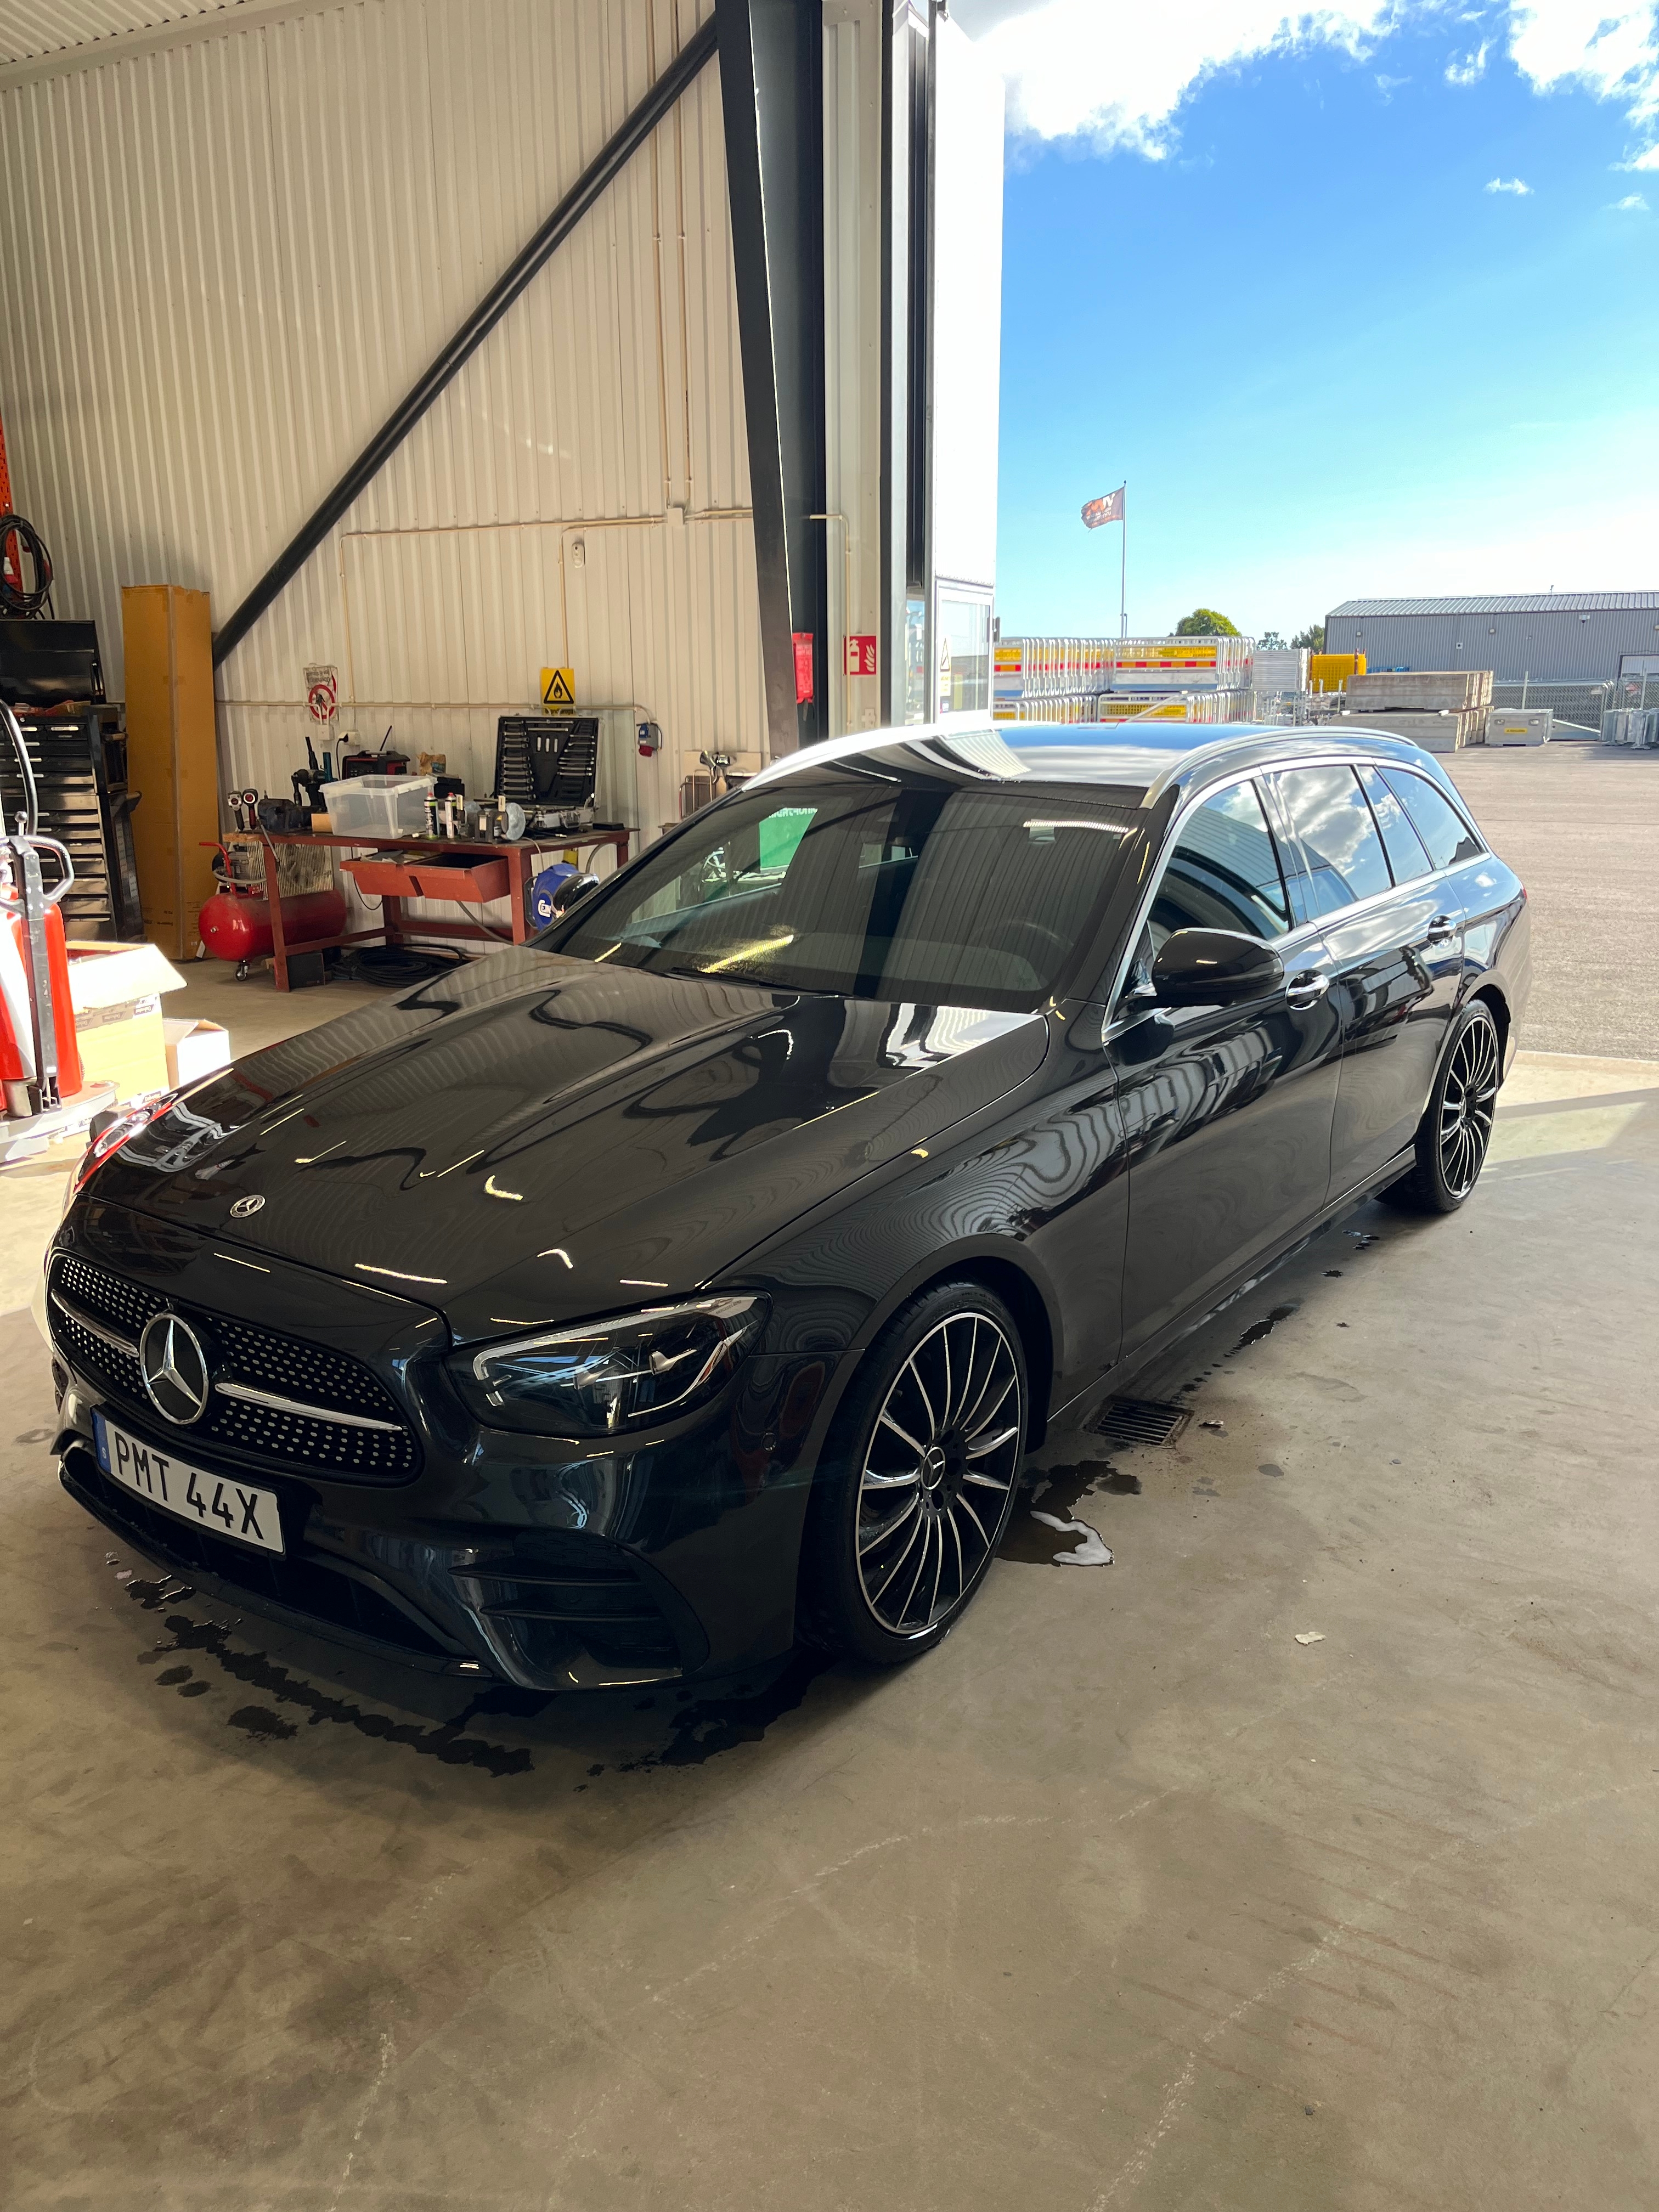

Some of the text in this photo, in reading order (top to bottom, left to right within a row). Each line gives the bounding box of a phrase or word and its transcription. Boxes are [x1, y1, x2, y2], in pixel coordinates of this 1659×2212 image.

[101, 1447, 106, 1459] S
[115, 1431, 264, 1540] PMT 44X
